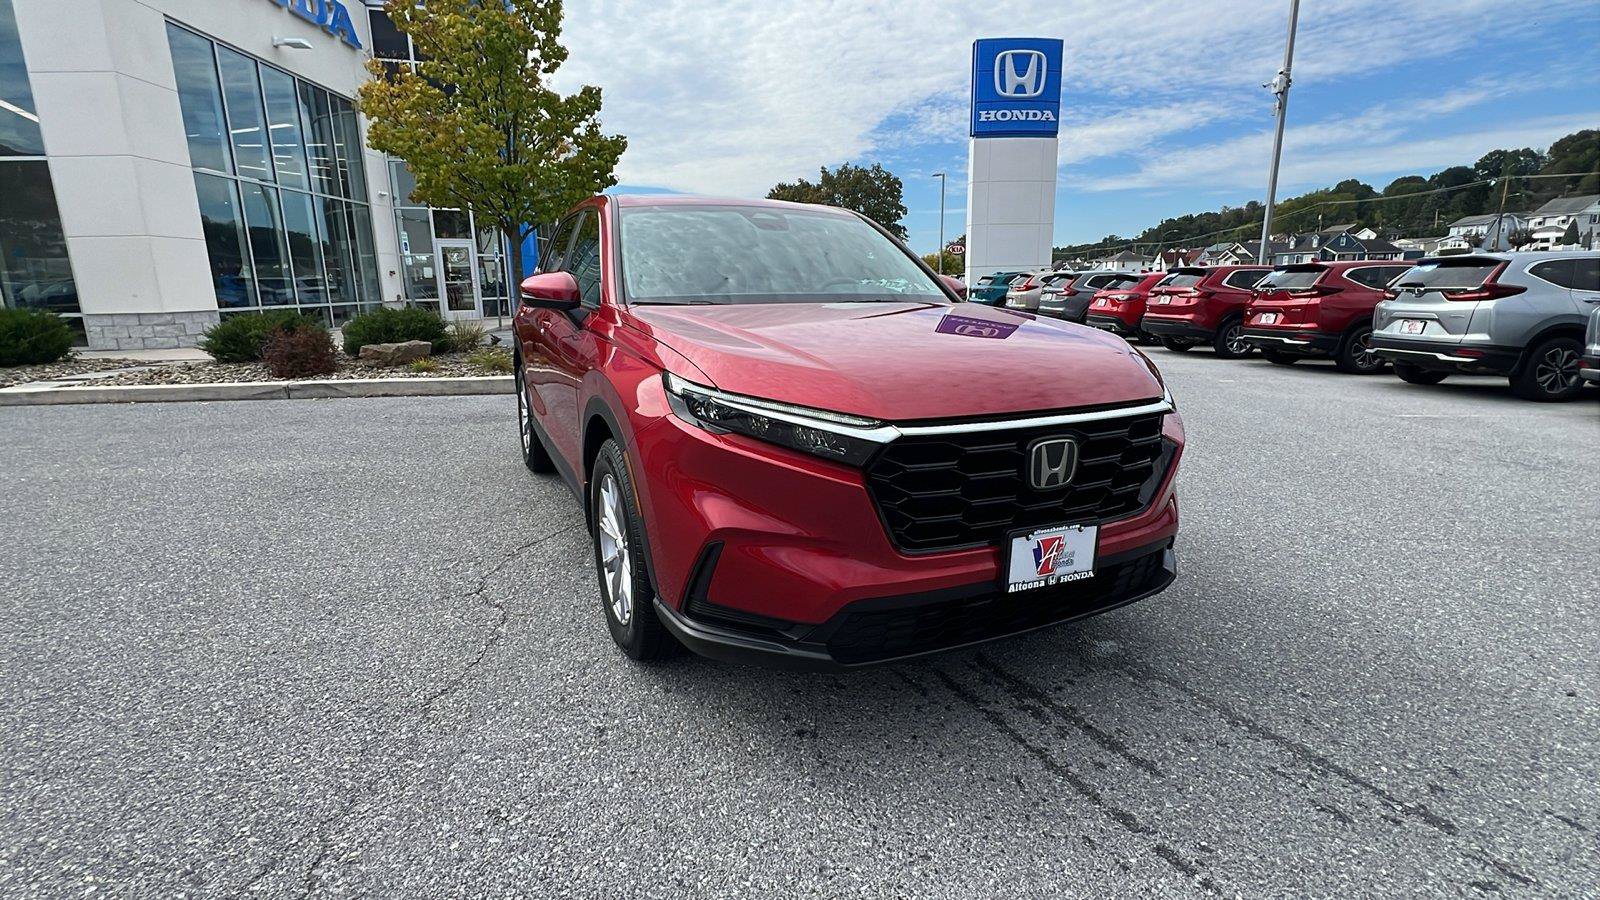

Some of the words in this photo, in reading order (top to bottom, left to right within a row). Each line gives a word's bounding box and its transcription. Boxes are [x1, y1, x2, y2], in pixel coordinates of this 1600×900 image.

[268, 0, 363, 49] DA
[979, 110, 1056, 121] HONDA
[1008, 581, 1045, 592] Altoona
[1060, 571, 1094, 582] HONDA
